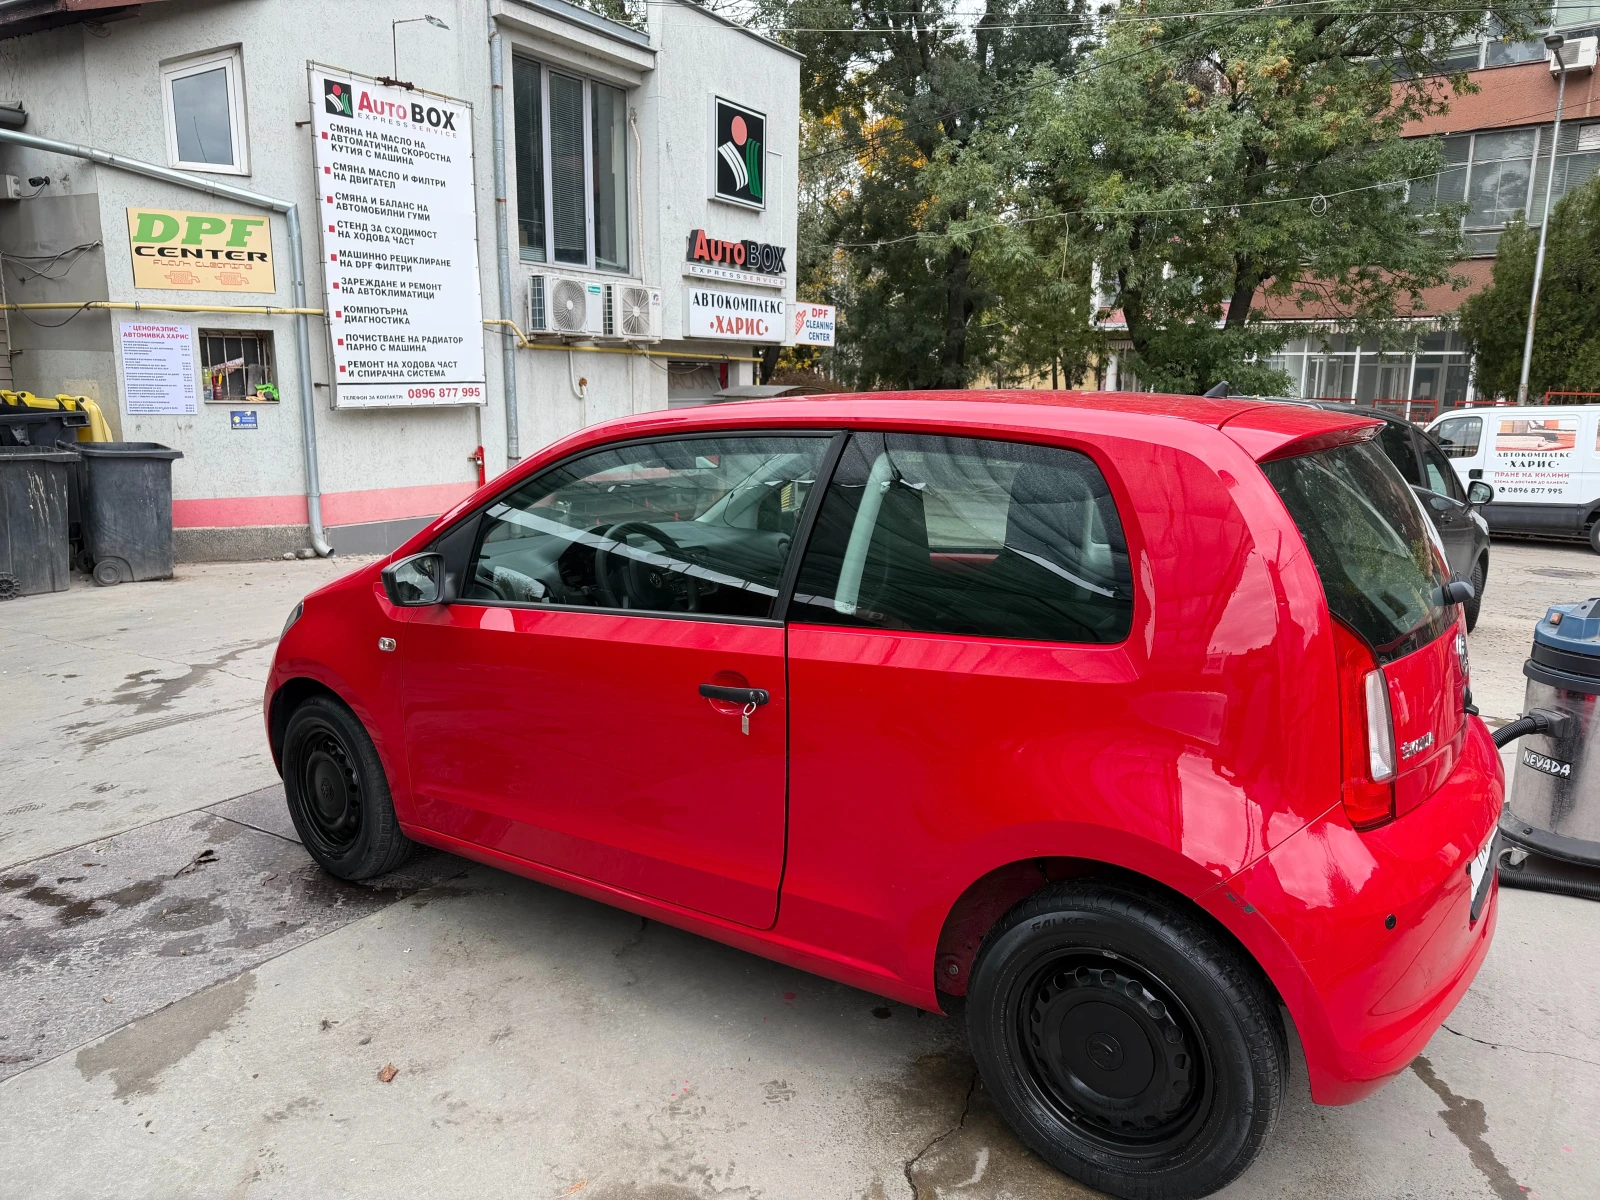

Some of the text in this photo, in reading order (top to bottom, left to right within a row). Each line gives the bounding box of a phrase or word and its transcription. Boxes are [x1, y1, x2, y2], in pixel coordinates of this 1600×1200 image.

[358, 112, 457, 138] EXPRESS SERVICE
[411, 102, 456, 131] BOX
[330, 123, 426, 149] СМЯНА НА МАСЛО НА
[331, 134, 452, 163] АВТОМАТИЧНА СКОРОСТНА
[332, 143, 363, 156] КУТИЯ
[374, 152, 414, 165] МАШИНА
[333, 162, 446, 188] СМЯНА МАСЛО И ФИЛТРИ
[334, 172, 396, 189] НА ДВИГАТЕЛ
[335, 192, 428, 212] СМЯНА И БАЛАНС НА
[336, 202, 430, 221] АВТОМОБИЛНИ ГУМИ
[132, 212, 264, 247] DPF
[337, 220, 437, 239] СТЕНД ЗА СХОДИМОСТ
[338, 230, 414, 245] НА ХОДОВА ЧАСТ
[135, 246, 268, 262] CENTER
[339, 250, 451, 267] МАШИННО РЕЦИКЛИРАНЕ
[747, 240, 786, 273] BOX
[340, 260, 412, 272] НА DPF ФИЛТРИ
[341, 277, 397, 288] ЗАРЕЖДАНЕ
[409, 282, 442, 291] РЕМОНТ
[692, 267, 784, 285] EXPRESS SERVICE
[358, 288, 434, 300] АВТОКЛИМАТИЦИ
[344, 306, 408, 316] КОМПЮТЪРНА
[693, 292, 783, 314] АВТОКОМПЛЕКС
[344, 315, 410, 325] ДИАГНОСТИКА
[812, 308, 828, 318] DPF
[806, 320, 834, 331] CLEANING
[346, 334, 405, 343] ПОЧИСТВАНЕ
[422, 336, 463, 345] РАДИАТОР
[808, 332, 830, 341] CENTER
[389, 344, 427, 352] МАШИНА
[358, 370, 405, 378] СПИРАЧНА
[407, 369, 446, 377] СИСТЕМА
[402, 361, 435, 369] ХОДОВА
[408, 387, 480, 399] 0896 877 995
[1524, 750, 1570, 776] NEVADA
